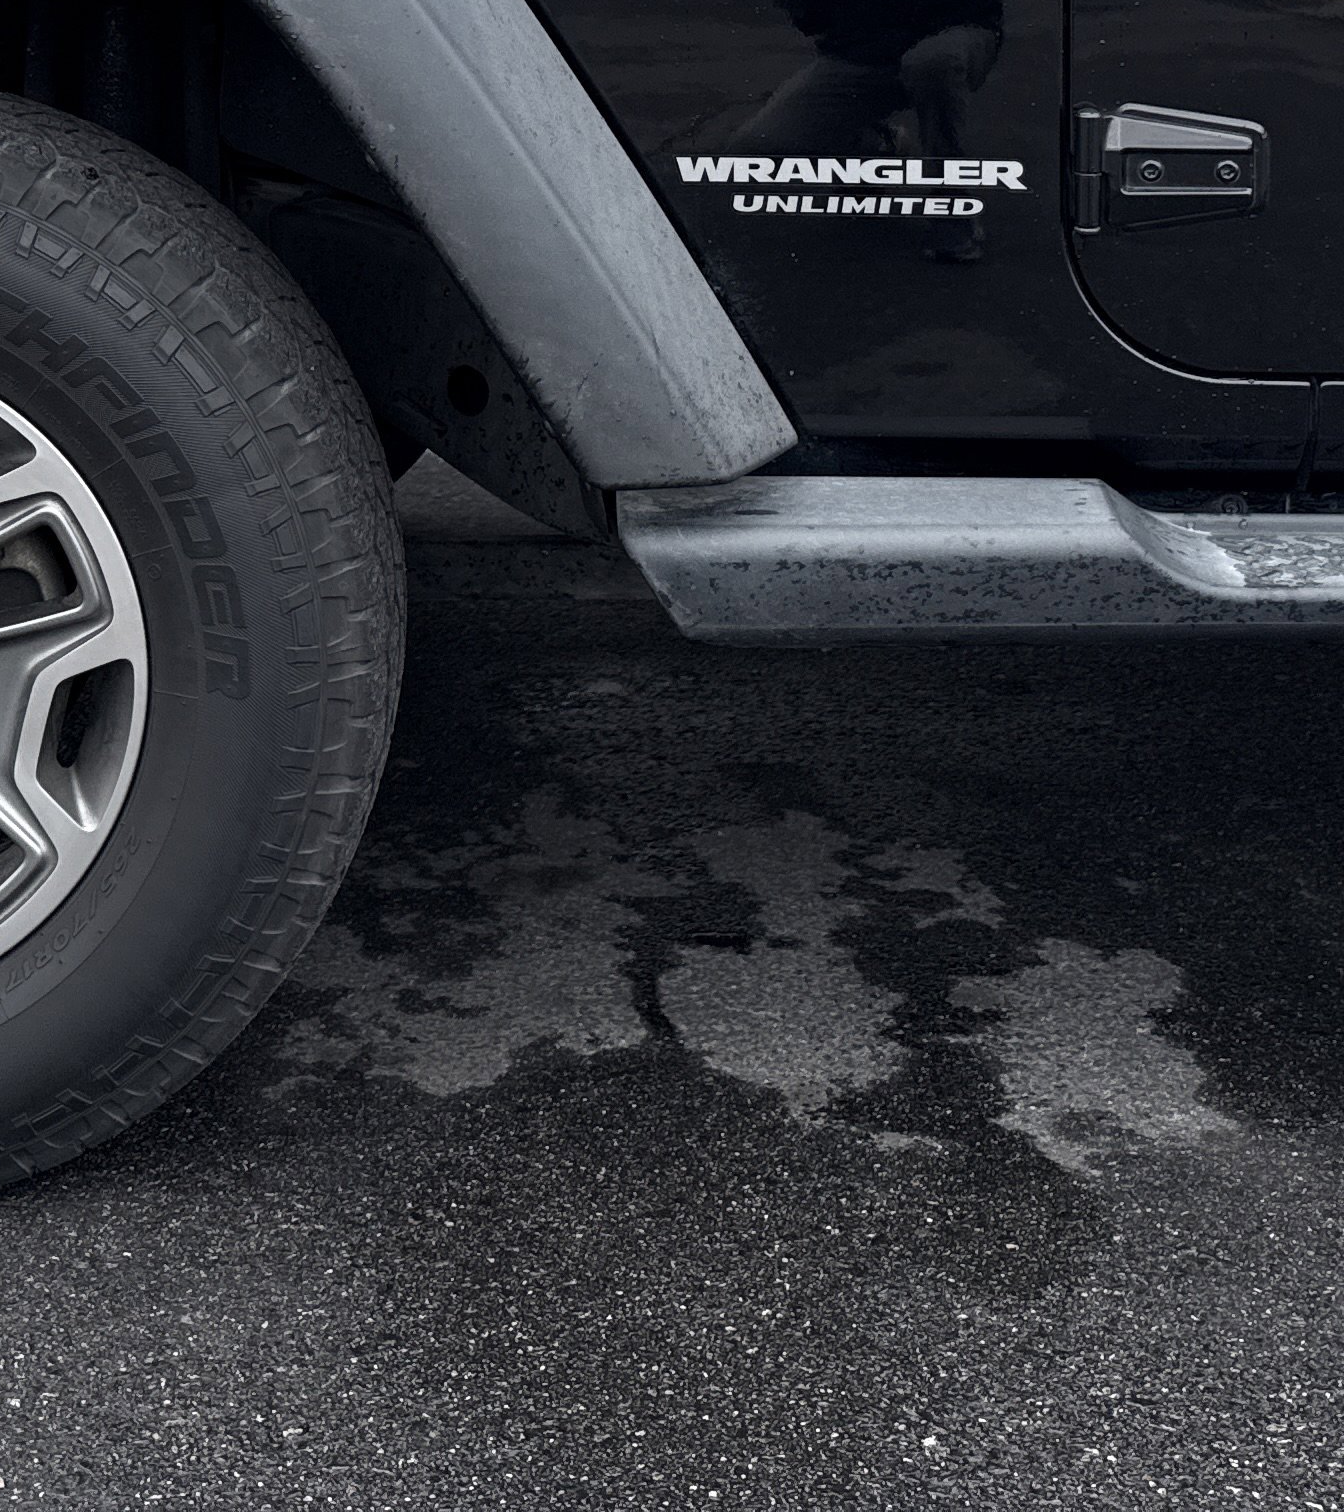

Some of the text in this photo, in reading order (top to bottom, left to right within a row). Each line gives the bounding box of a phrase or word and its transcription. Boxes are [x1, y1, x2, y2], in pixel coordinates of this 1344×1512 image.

[675, 156, 1028, 190] WRANGLER
[732, 194, 984, 216] UNLIMITED
[6, 827, 142, 993] 265/70R17
